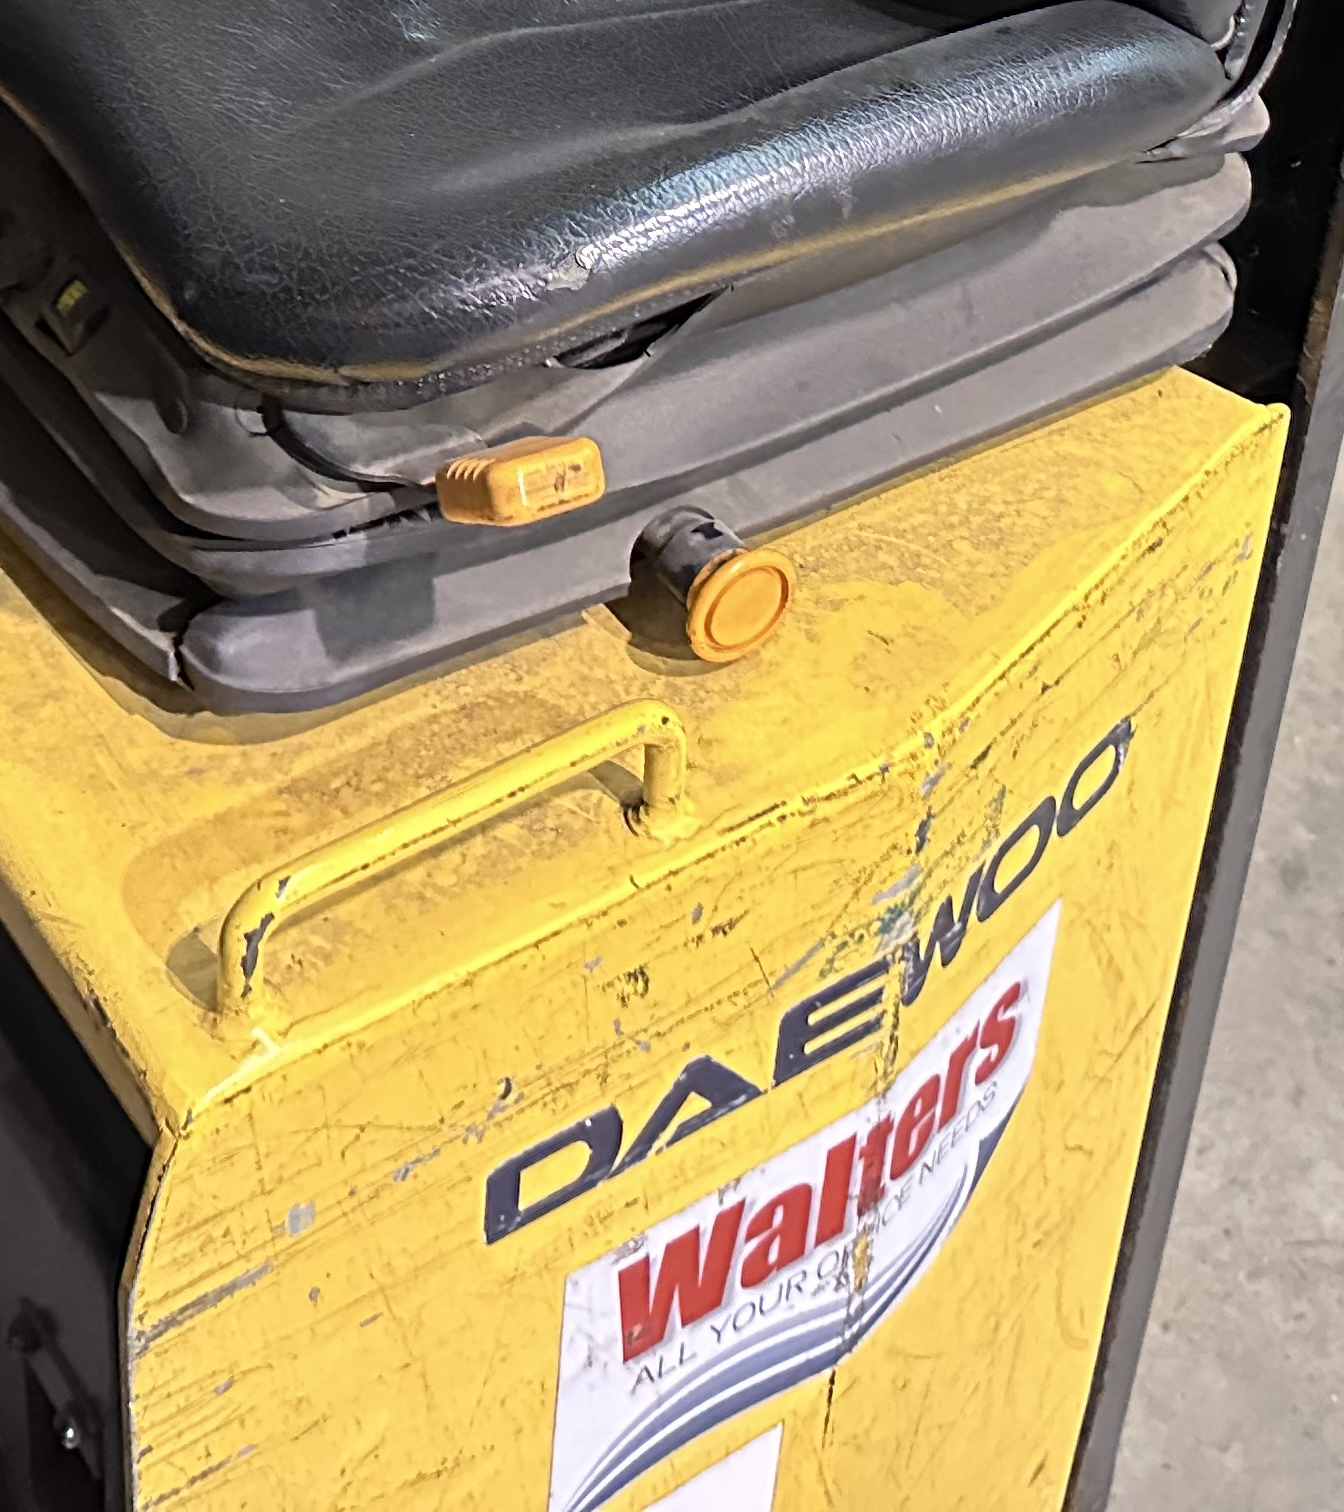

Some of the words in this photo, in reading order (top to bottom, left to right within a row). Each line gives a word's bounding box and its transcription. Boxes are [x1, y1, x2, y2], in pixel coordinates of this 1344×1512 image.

[483, 717, 1133, 1245] DAEWOO
[617, 981, 1023, 1363] Walters
[629, 1342, 697, 1395] ALL
[709, 1269, 807, 1343] YOUR
[816, 1175, 914, 1281] OICE
